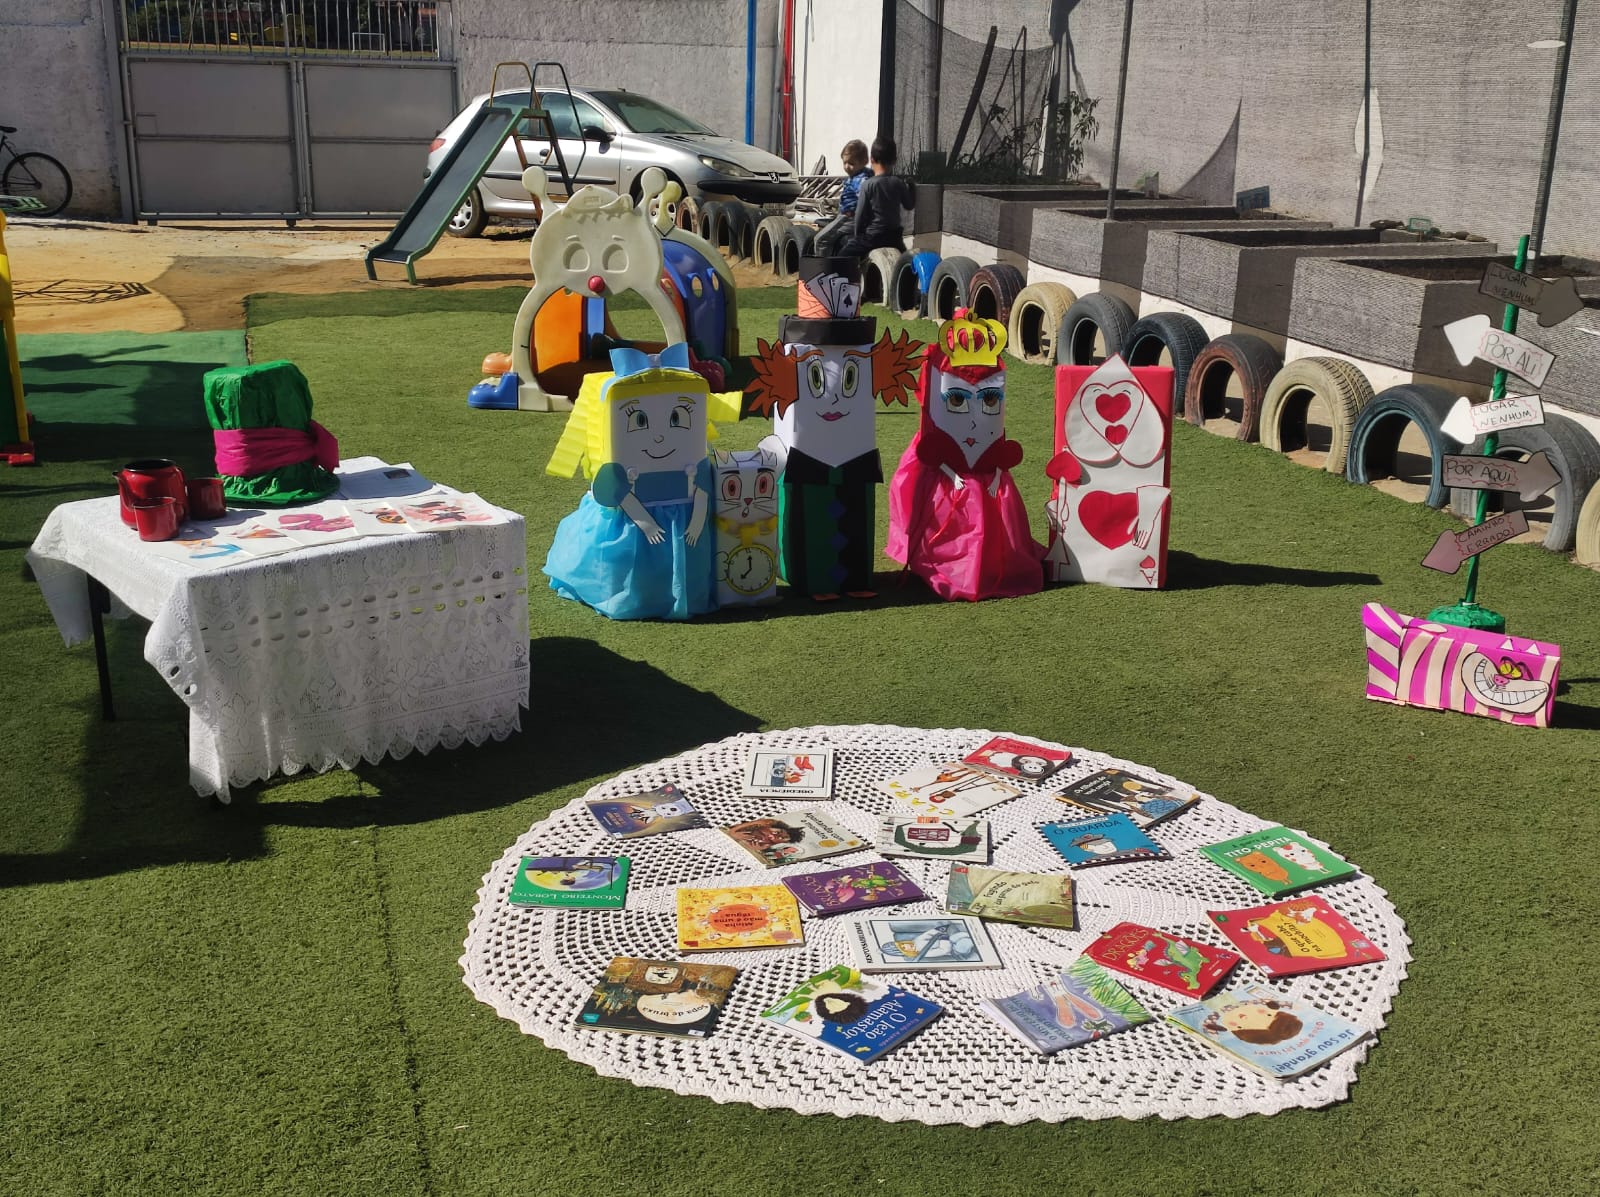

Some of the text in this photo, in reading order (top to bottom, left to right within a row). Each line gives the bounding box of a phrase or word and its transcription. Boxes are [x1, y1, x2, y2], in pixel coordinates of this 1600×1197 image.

[1490, 268, 1527, 288] LUGAR
[1493, 285, 1537, 307] NENHUM
[1486, 334, 1537, 375] POR ALI
[1472, 399, 1518, 416] LUGAR
[1480, 409, 1532, 428] NENHUM
[1446, 460, 1511, 482] POR AQUI
[1458, 516, 1505, 543] CAMINHO
[1466, 528, 1510, 553] ERRADO
[1139, 569, 1157, 585] A
[888, 781, 955, 816] CLARA
[1068, 820, 1123, 835] GUARDA
[1224, 847, 1252, 858] TITO
[1253, 837, 1292, 850] PEPITA
[514, 892, 557, 900] LOBATO
[1277, 925, 1294, 938] cabe
[854, 921, 874, 964] RESPONSABILIDADE
[1102, 928, 1149, 961] DRAGÕES
[1290, 937, 1305, 948] que
[1312, 944, 1323, 952] na
[642, 1006, 670, 1017] bruxa
[842, 999, 904, 1040] Adamastor
[865, 1013, 907, 1040] O leão
[1271, 1029, 1356, 1074] Já sou grande!
